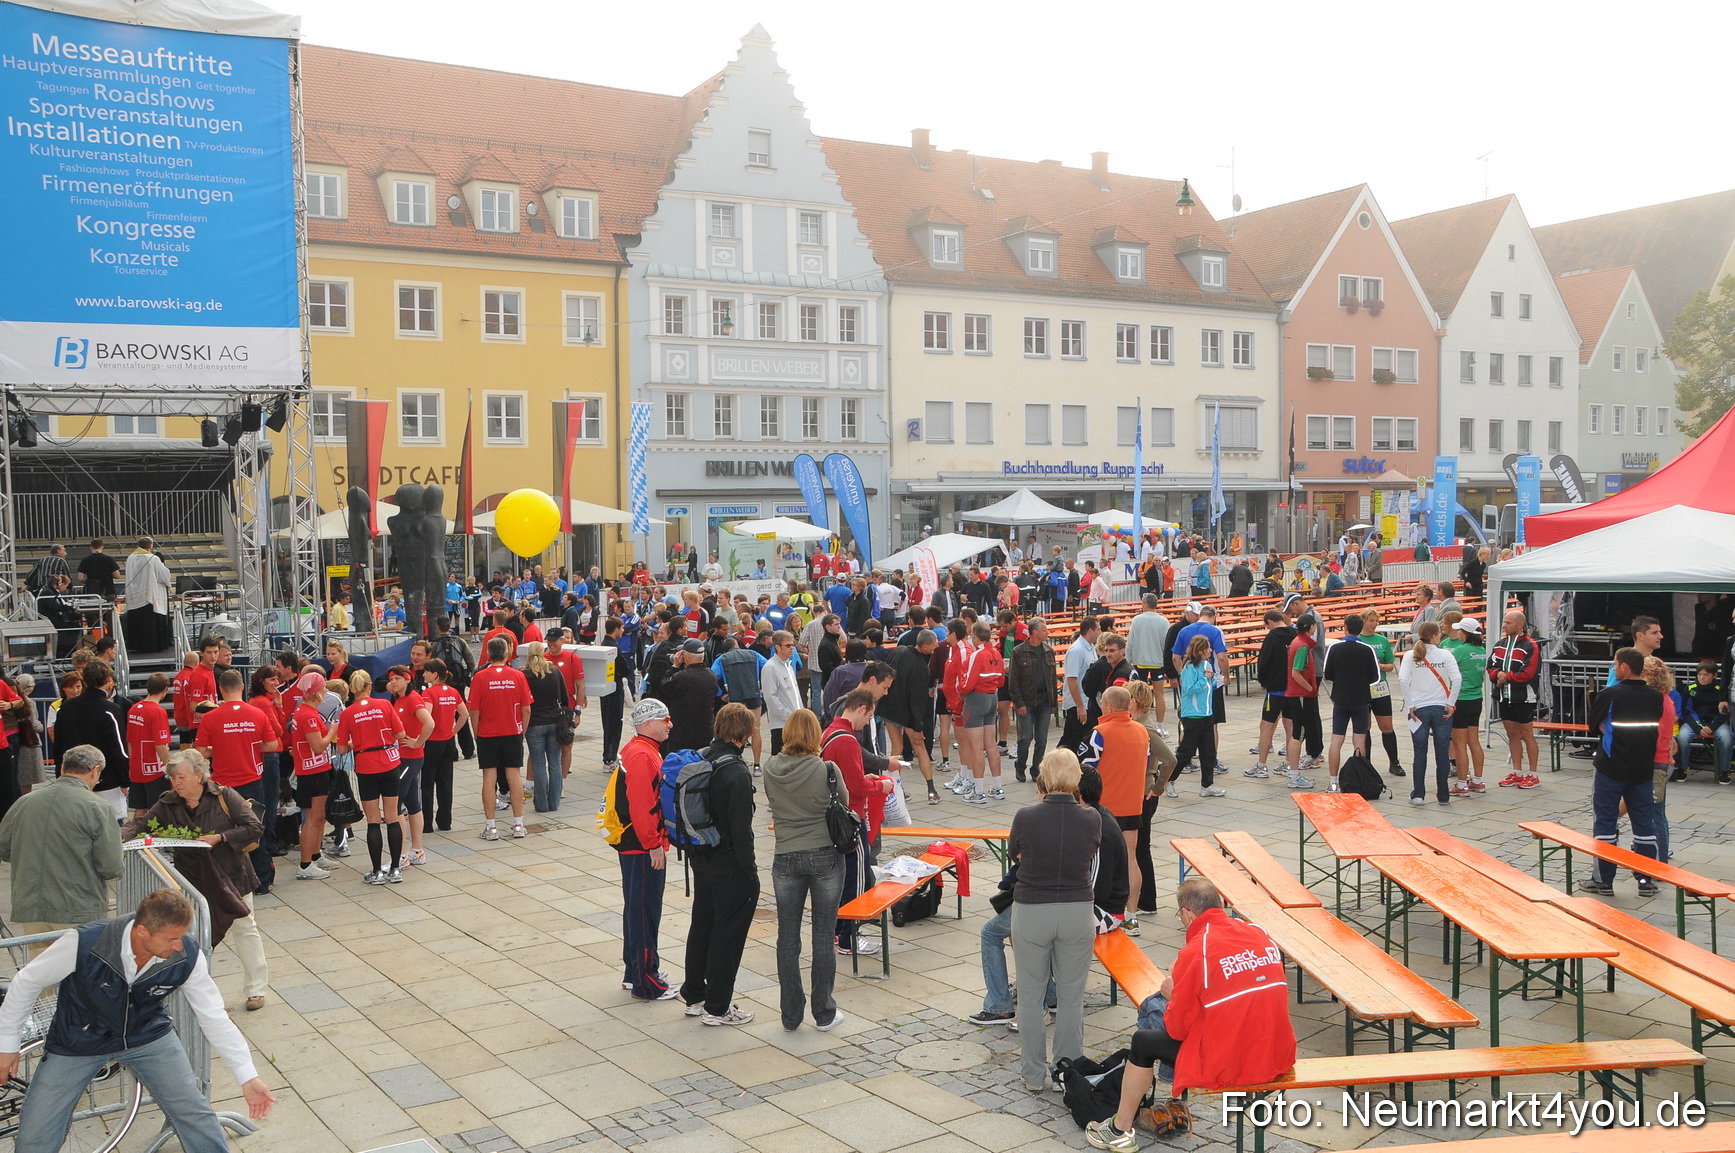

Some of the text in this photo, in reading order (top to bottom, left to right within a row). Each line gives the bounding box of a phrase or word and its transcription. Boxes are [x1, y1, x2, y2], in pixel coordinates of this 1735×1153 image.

[32, 32, 233, 76] Messeauftritte
[2, 54, 256, 95] Hauptversammlungen Get together
[36, 80, 215, 111] Tagungen Roadshows
[28, 97, 243, 133] Sportveranstaltungen
[8, 117, 264, 155] Installationen TV-Produktionen
[29, 143, 193, 168] Kulturveranstaltungen
[59, 163, 246, 184] Fashionshows Produktpräsentationen
[42, 175, 234, 203] Firmeneröffnungen
[70, 196, 149, 209] Firmenjubiläum
[146, 211, 208, 223] Firmenfeiern
[76, 215, 196, 241] Kongresse
[141, 240, 190, 252] Musicals
[90, 248, 179, 267] Konzerte
[113, 265, 168, 277] Tourservice
[75, 295, 223, 313] www.barowski-ag.de
[96, 343, 212, 361] BAROWSKI
[219, 345, 249, 362] AG
[97, 361, 248, 372] Veranstaltungs- und Mediensysteme
[718, 358, 819, 376] BRILLEN WEBER
[705, 460, 768, 477] BRILLEN
[1002, 460, 1164, 478] Buchhandlung Ruppecht
[1436, 465, 1452, 473] maxi
[711, 506, 735, 514] BRILLEN
[354, 711, 367, 719] MAX
[1219, 949, 1258, 968] speck
[1221, 956, 1271, 980] pumpen
